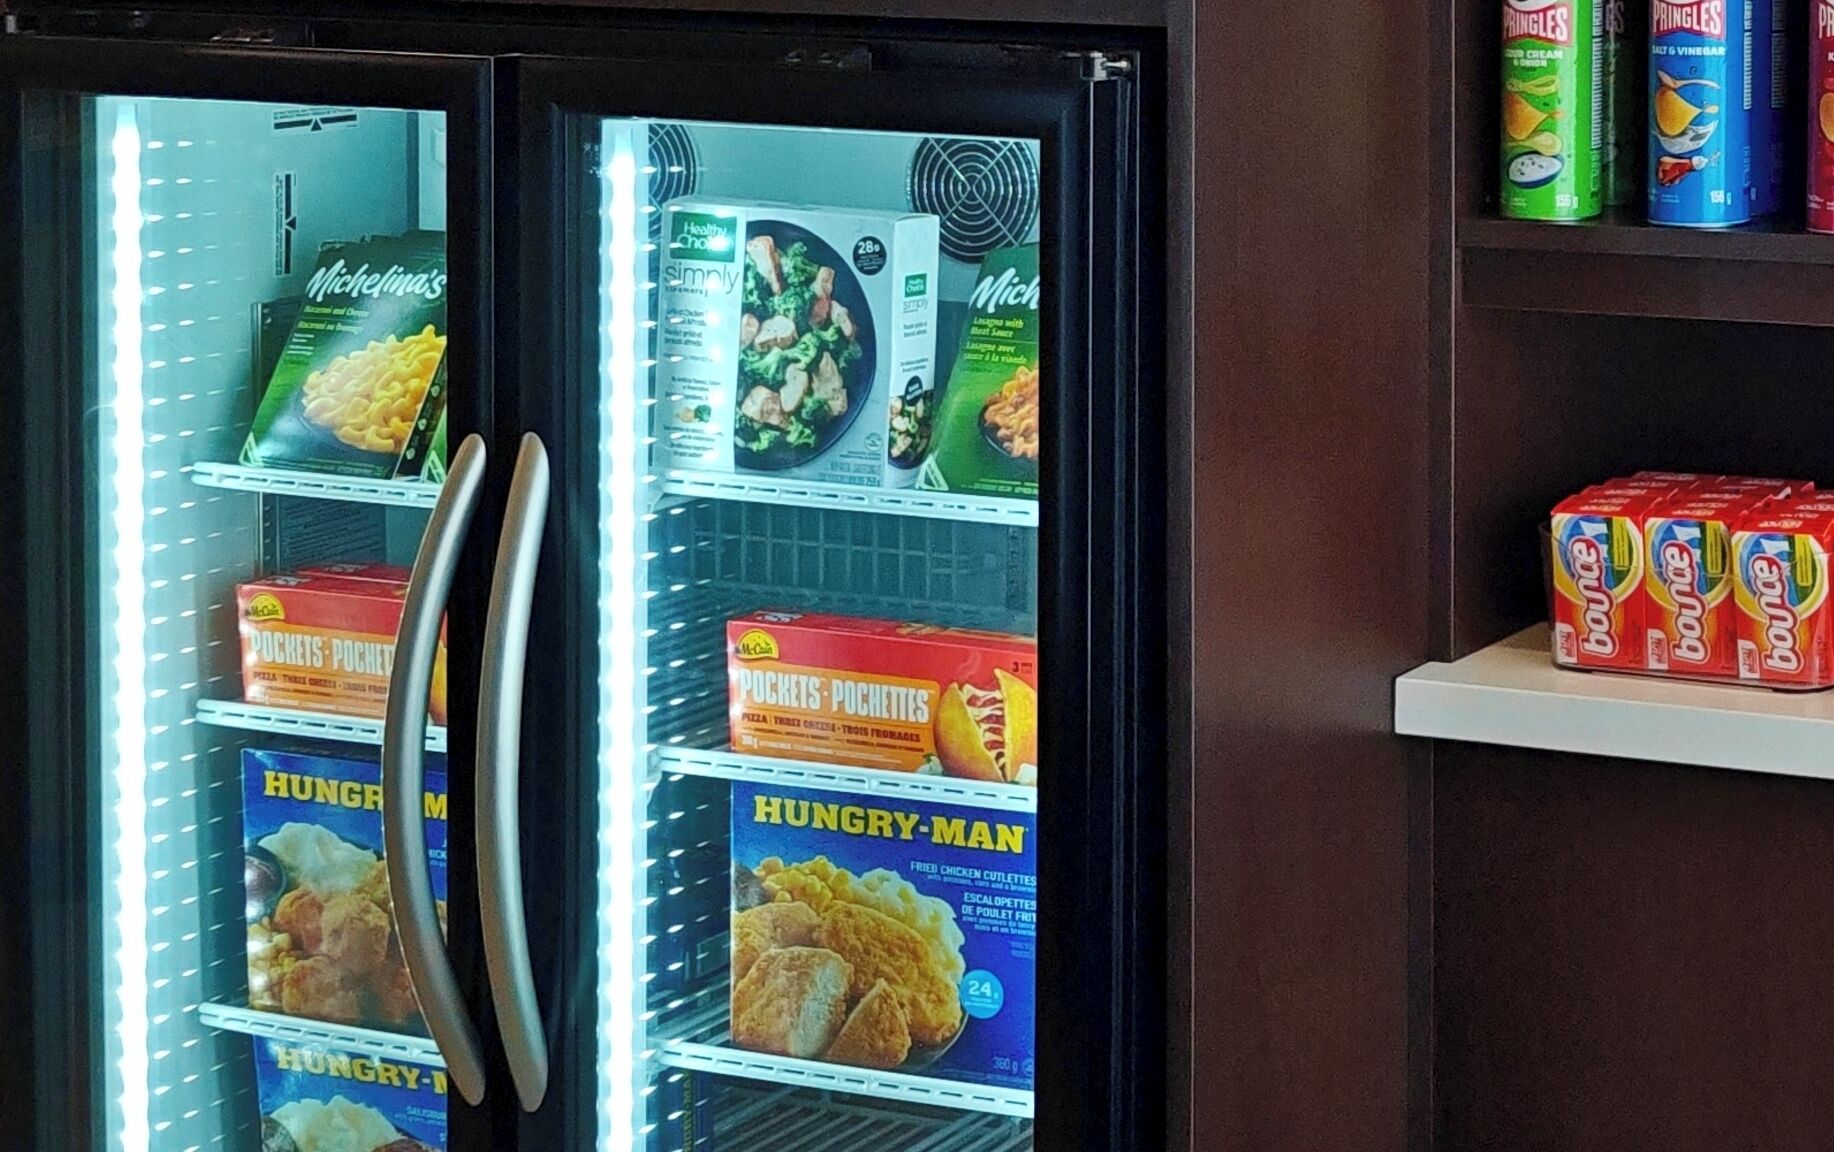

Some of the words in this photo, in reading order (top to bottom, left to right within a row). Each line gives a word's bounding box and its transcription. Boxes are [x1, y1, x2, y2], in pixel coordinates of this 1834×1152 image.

[1503, 5, 1568, 42] PRINGLES
[1654, 0, 1722, 35] PRINGLES
[1527, 50, 1563, 59] CREAM
[1677, 46, 1725, 55] VINEGAR
[684, 222, 727, 236] Healthy
[305, 258, 447, 302] Michelina's
[665, 262, 739, 294] simply
[1571, 538, 1618, 659] bounce
[1665, 542, 1709, 663] bounce
[1755, 555, 1802, 672] bounce
[251, 629, 324, 668] POCKETS
[742, 642, 774, 656] McCain
[1012, 661, 1020, 673] 3
[740, 669, 821, 710] POCKETS
[831, 679, 930, 724] POCHETTES
[742, 712, 768, 725] PIZZA
[774, 715, 800, 728] THREE
[842, 724, 869, 738] TROIS
[871, 727, 921, 743] FROMAGES
[754, 795, 1024, 854] HUNGRY-MAN
[911, 861, 938, 873] FRIED
[940, 865, 981, 879] CHICKEN
[983, 870, 1036, 886] CUTLETTES
[961, 904, 974, 915] DE
[976, 906, 1014, 920] POULET
[964, 892, 1036, 910] ESCALOPETTES
